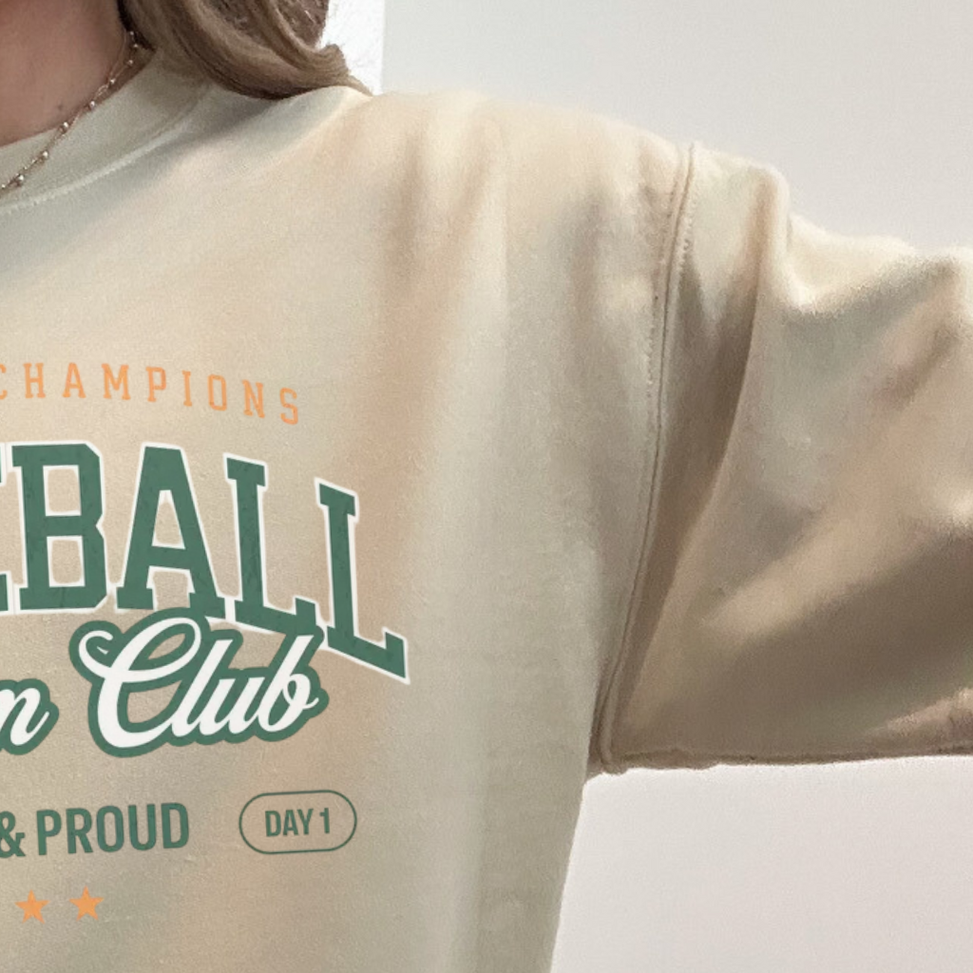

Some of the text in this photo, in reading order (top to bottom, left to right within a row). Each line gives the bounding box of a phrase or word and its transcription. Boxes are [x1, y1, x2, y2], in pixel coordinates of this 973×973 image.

[76, 616, 320, 749] Club
[35, 802, 190, 857] PROUD
[264, 807, 333, 839] DAY 1
